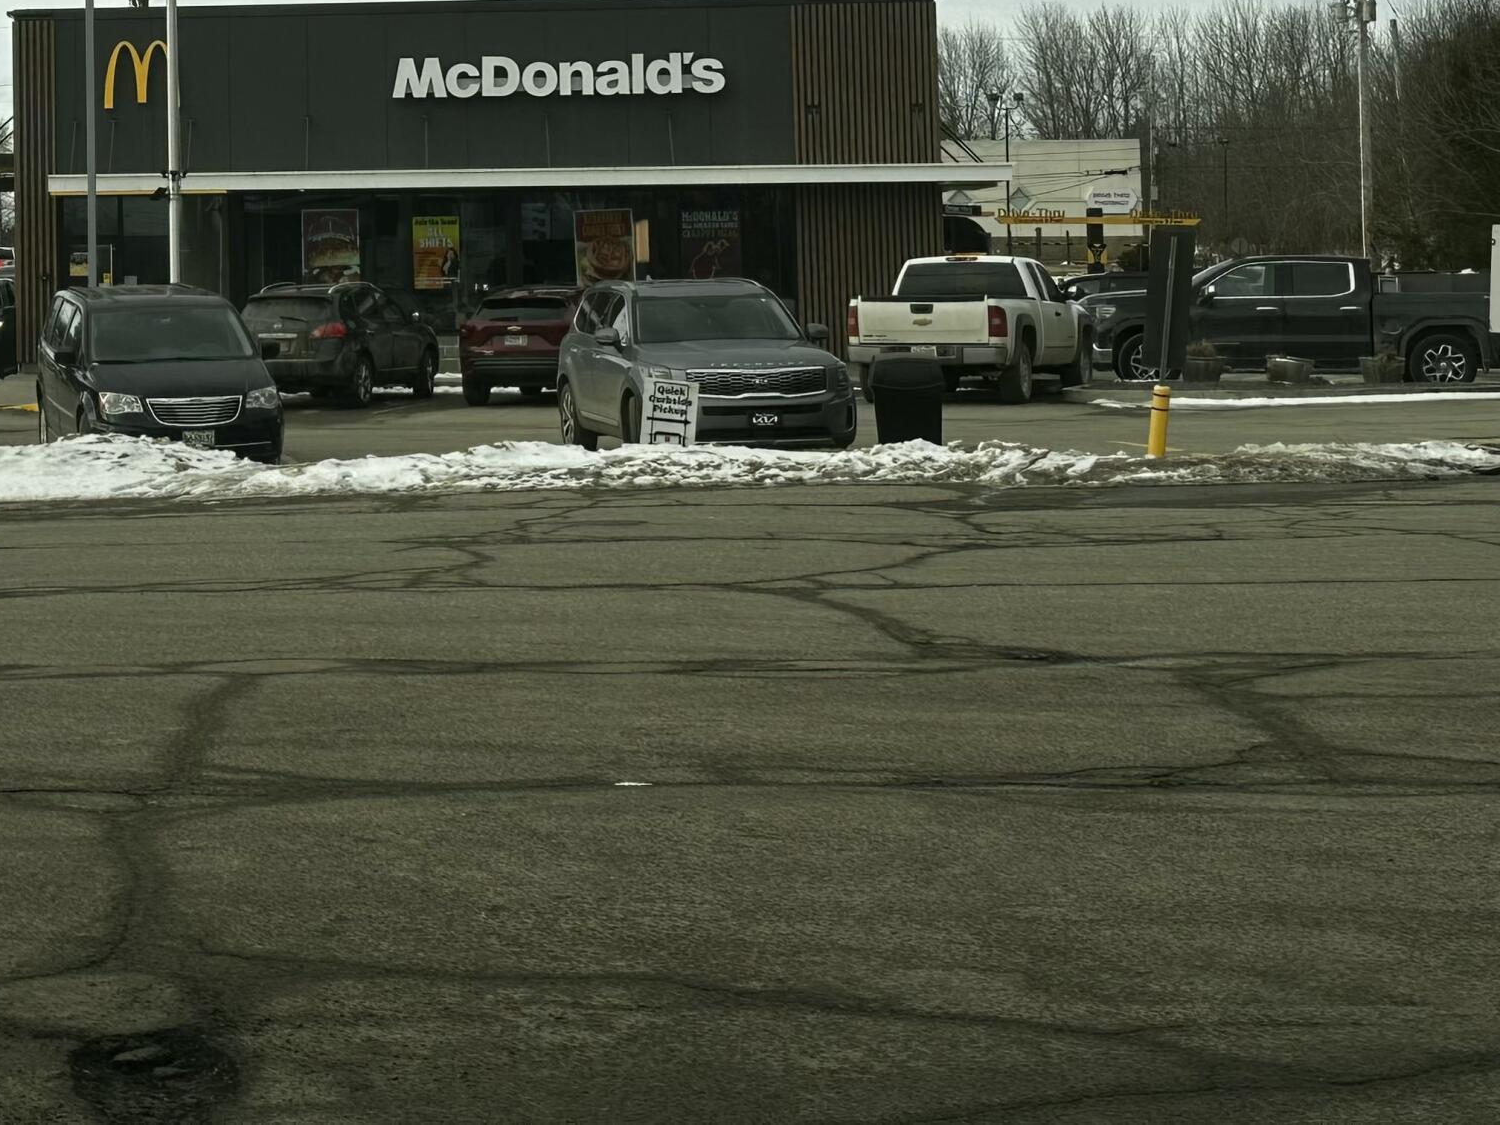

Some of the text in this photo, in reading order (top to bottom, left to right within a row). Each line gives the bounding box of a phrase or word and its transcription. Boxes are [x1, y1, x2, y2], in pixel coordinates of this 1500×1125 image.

[392, 51, 726, 98] McDonald's
[998, 208, 1065, 218] Drive-Thru
[658, 386, 685, 395] Quick
[653, 404, 687, 417] Pickup
